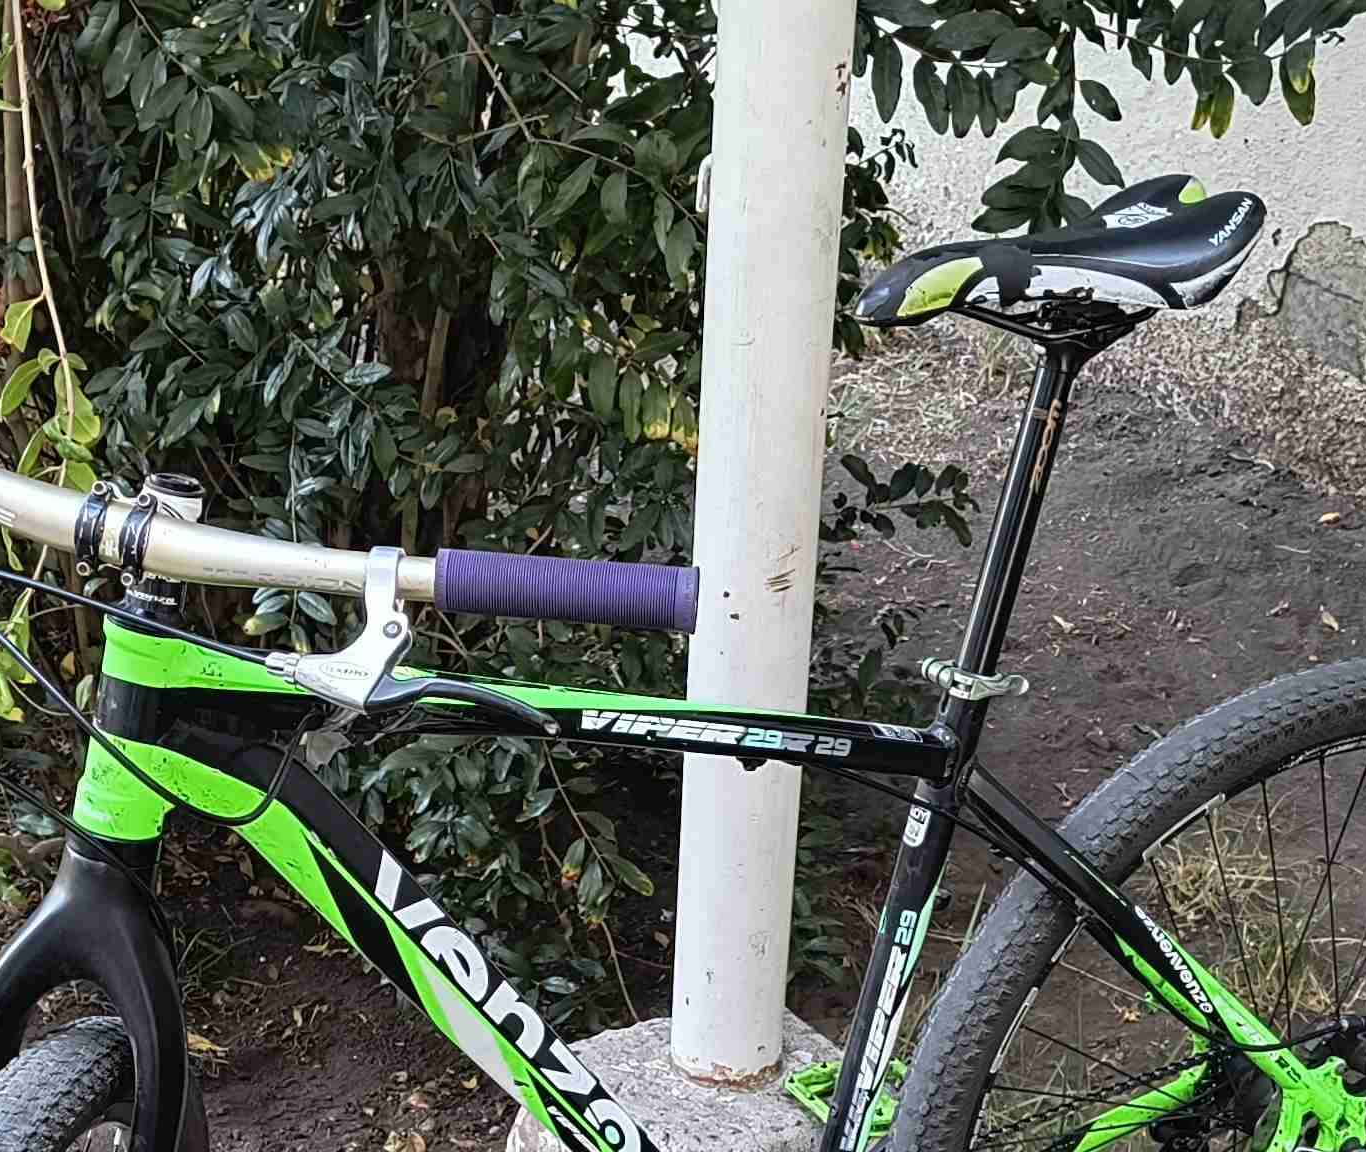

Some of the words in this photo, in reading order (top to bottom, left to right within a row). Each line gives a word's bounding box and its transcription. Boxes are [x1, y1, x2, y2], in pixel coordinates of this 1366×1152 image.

[1208, 197, 1253, 247] YANSAN
[814, 738, 852, 757] 29
[895, 909, 919, 946] 29
